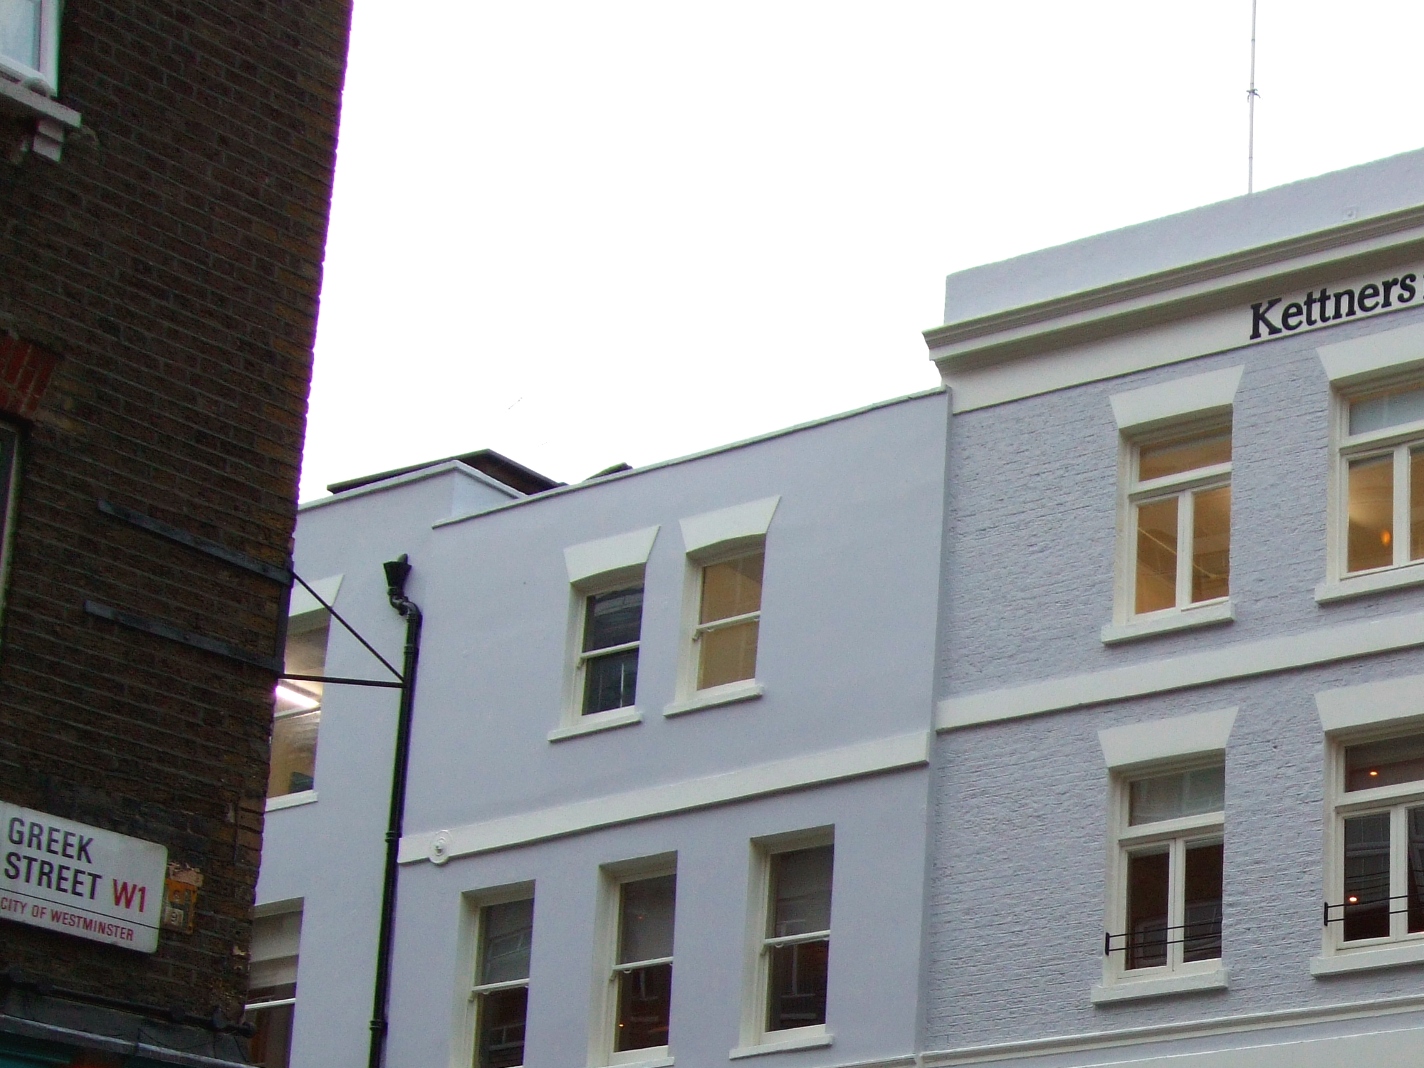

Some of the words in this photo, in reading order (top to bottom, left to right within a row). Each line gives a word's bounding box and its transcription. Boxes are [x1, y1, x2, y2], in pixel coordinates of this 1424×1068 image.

[1250, 272, 1417, 340] Kettners
[8, 817, 95, 864] GREEK
[4, 851, 103, 900] STREET
[112, 878, 148, 913] W1
[0, 896, 28, 915] CITY
[31, 904, 48, 919] OF
[50, 909, 135, 942] WESTMINSTER
